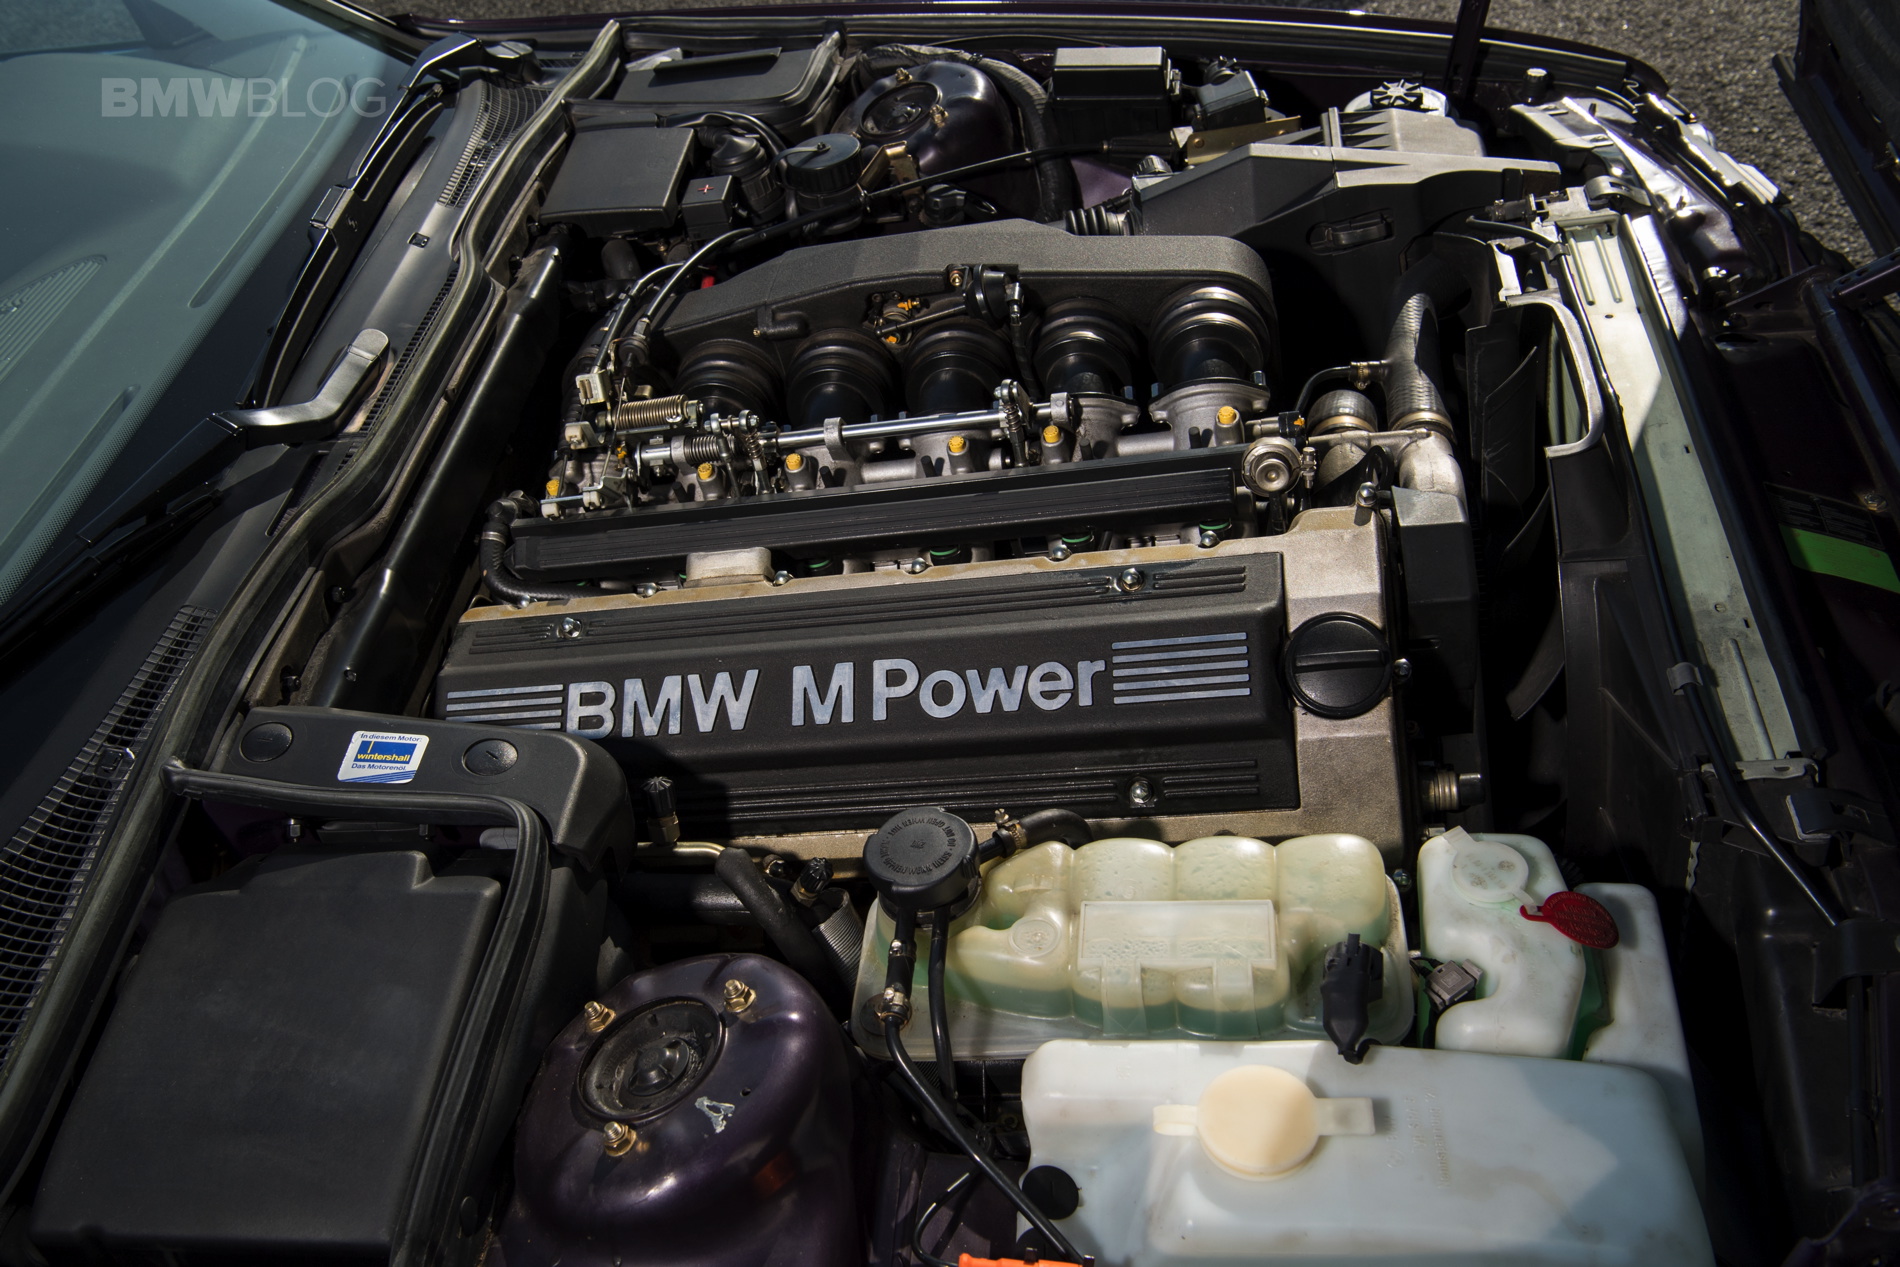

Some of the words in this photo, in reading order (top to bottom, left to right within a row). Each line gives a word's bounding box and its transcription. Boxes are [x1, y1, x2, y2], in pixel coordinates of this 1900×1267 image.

[566, 669, 759, 739] BMW
[791, 662, 854, 726] M
[872, 658, 1106, 720] Power
[357, 753, 410, 762] wintershall
